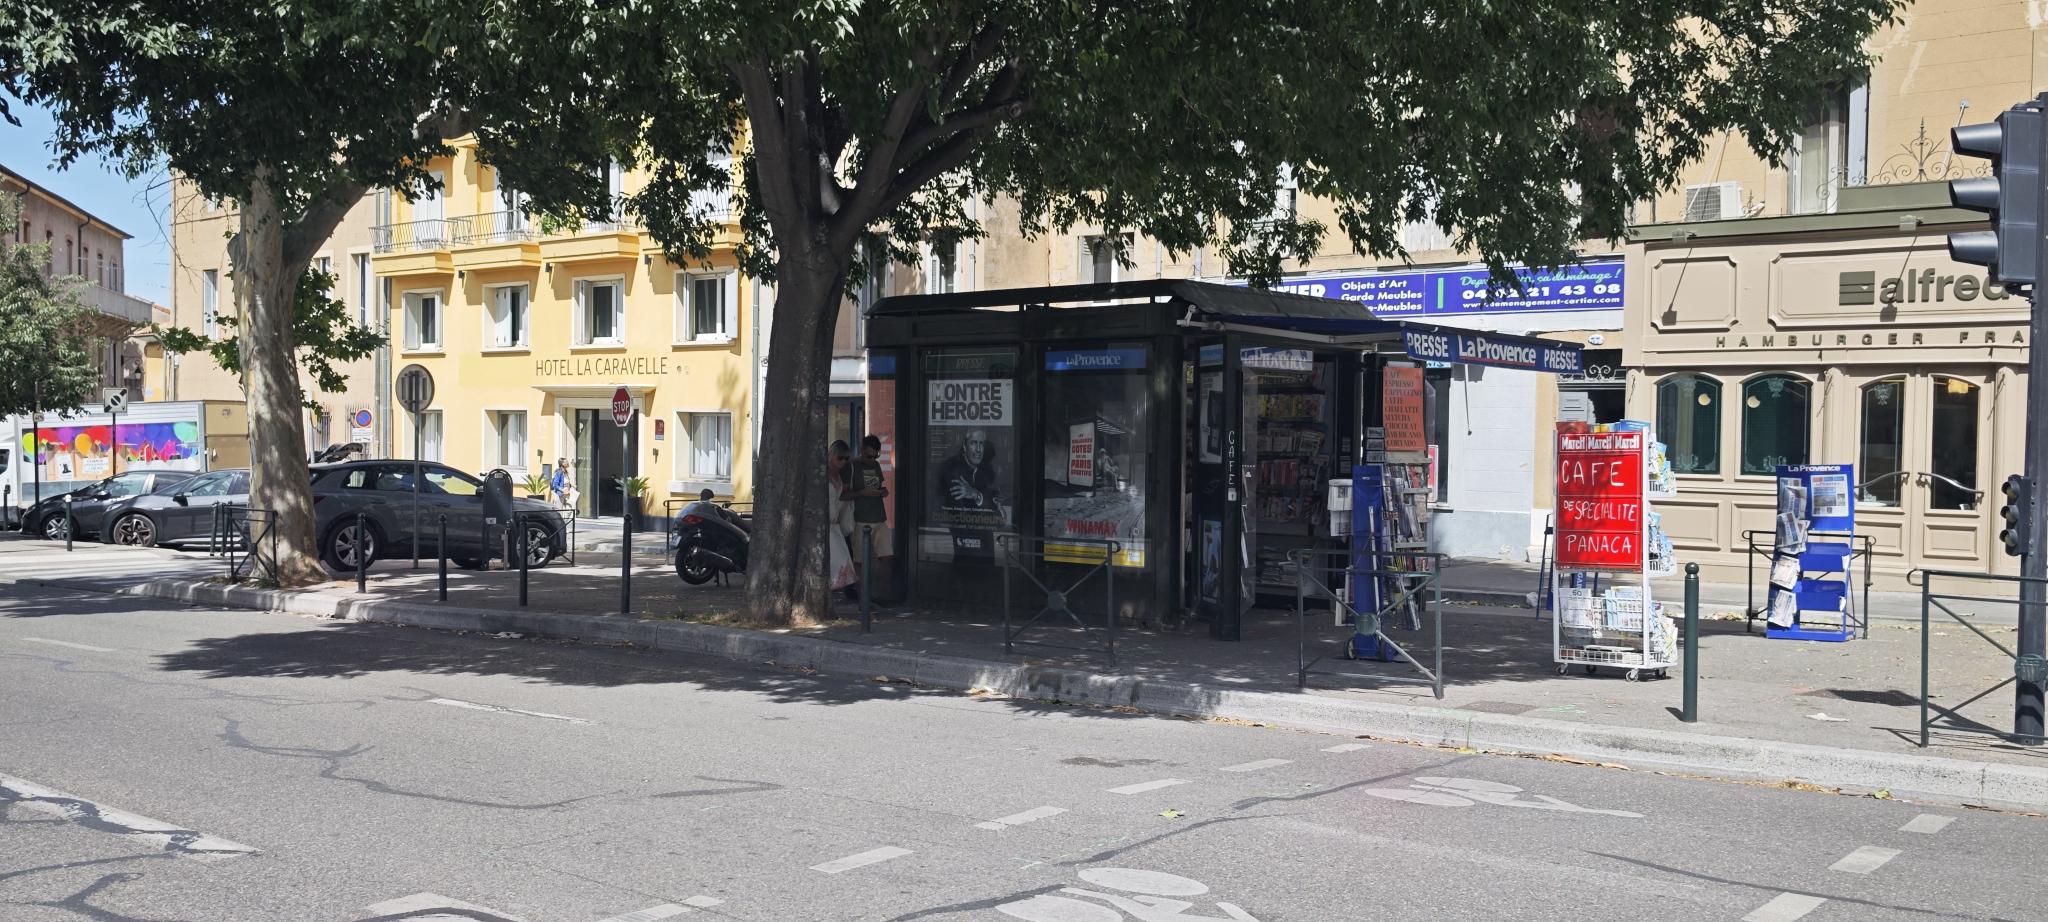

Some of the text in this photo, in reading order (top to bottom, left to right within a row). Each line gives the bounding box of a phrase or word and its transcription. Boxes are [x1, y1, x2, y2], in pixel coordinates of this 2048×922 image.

[1341, 279, 1407, 292] Objets d'Art
[1341, 288, 1422, 301] Garde Meubles
[1462, 289, 1487, 300] 04
[1527, 286, 1550, 297] 21
[1558, 285, 1586, 296] 43
[1593, 283, 1621, 295] 08
[1368, 301, 1422, 312] e-Meubles
[1462, 297, 1620, 309] ww.demenagement-cartier.com
[1716, 330, 2025, 349] HAMBURGER FRA
[1406, 331, 1449, 358] PRESSE
[1543, 348, 1580, 370] PRESSE
[535, 356, 668, 376] HOTEL LA CARAVELLE
[931, 382, 1002, 401] MONTRE
[613, 400, 630, 413] STOP
[931, 401, 1003, 421] HEROES
[1070, 459, 1092, 470] PARIS
[1227, 430, 1236, 485] CAFE
[1561, 459, 1625, 487] CAFE
[1563, 500, 1638, 522] DE SPECIALITE
[1065, 519, 1118, 538] WINAMAX
[1566, 534, 1632, 554] PANACA
